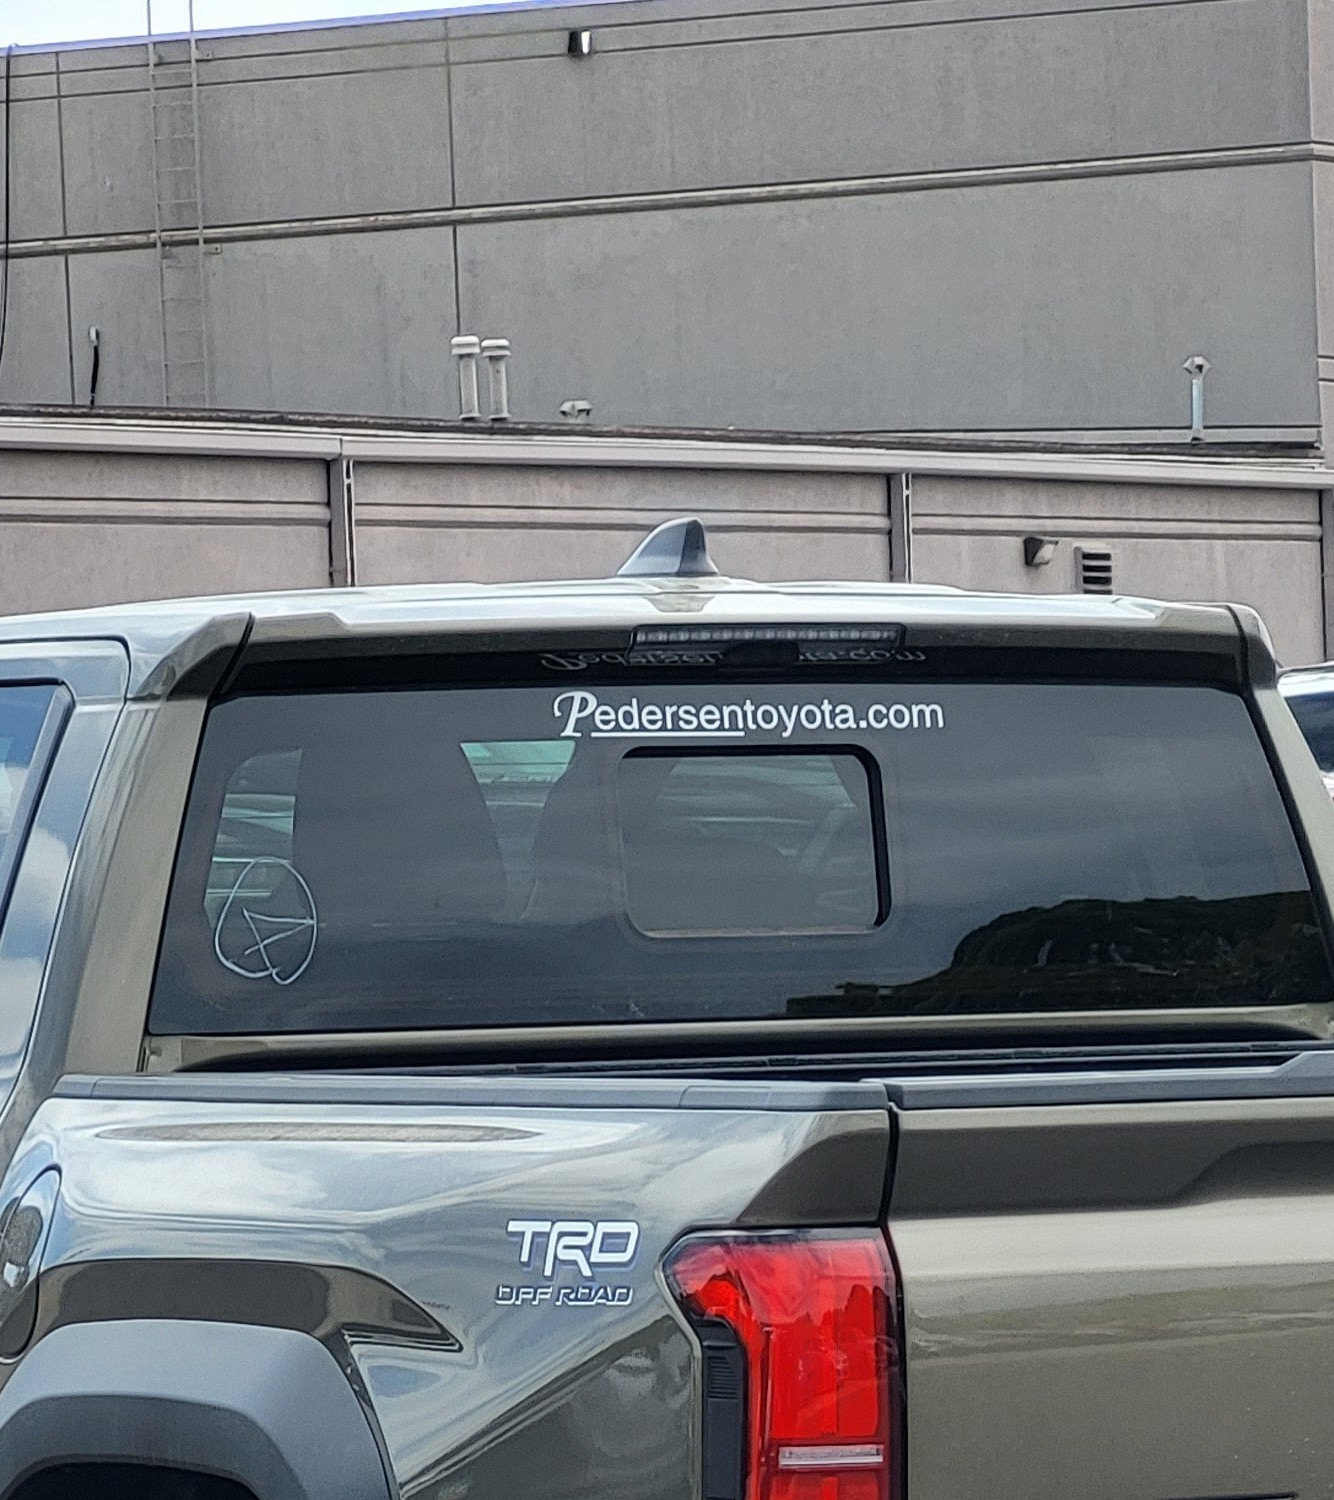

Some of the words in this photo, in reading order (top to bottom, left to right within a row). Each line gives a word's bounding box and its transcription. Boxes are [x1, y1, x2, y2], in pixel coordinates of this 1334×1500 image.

[552, 690, 945, 737] Pedersentoyota.com
[507, 1219, 640, 1277] TRD
[495, 1284, 553, 1306] OFF
[555, 1284, 634, 1306] ROAD
